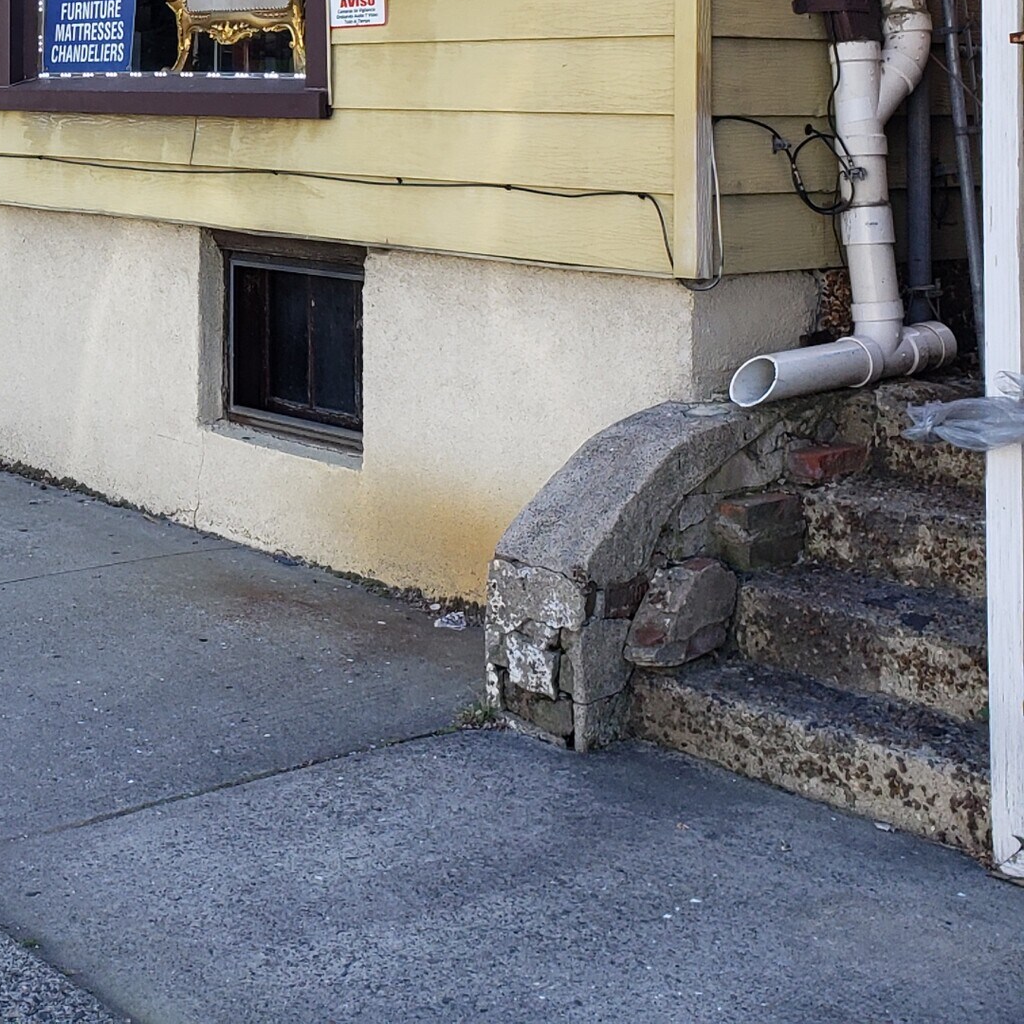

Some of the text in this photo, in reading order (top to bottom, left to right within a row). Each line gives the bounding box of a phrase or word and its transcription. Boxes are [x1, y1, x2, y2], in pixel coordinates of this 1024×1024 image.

[60, 0, 121, 21] FURNITURE
[54, 21, 124, 42] MATTRESSES
[51, 42, 124, 63] CHANDELIERS
